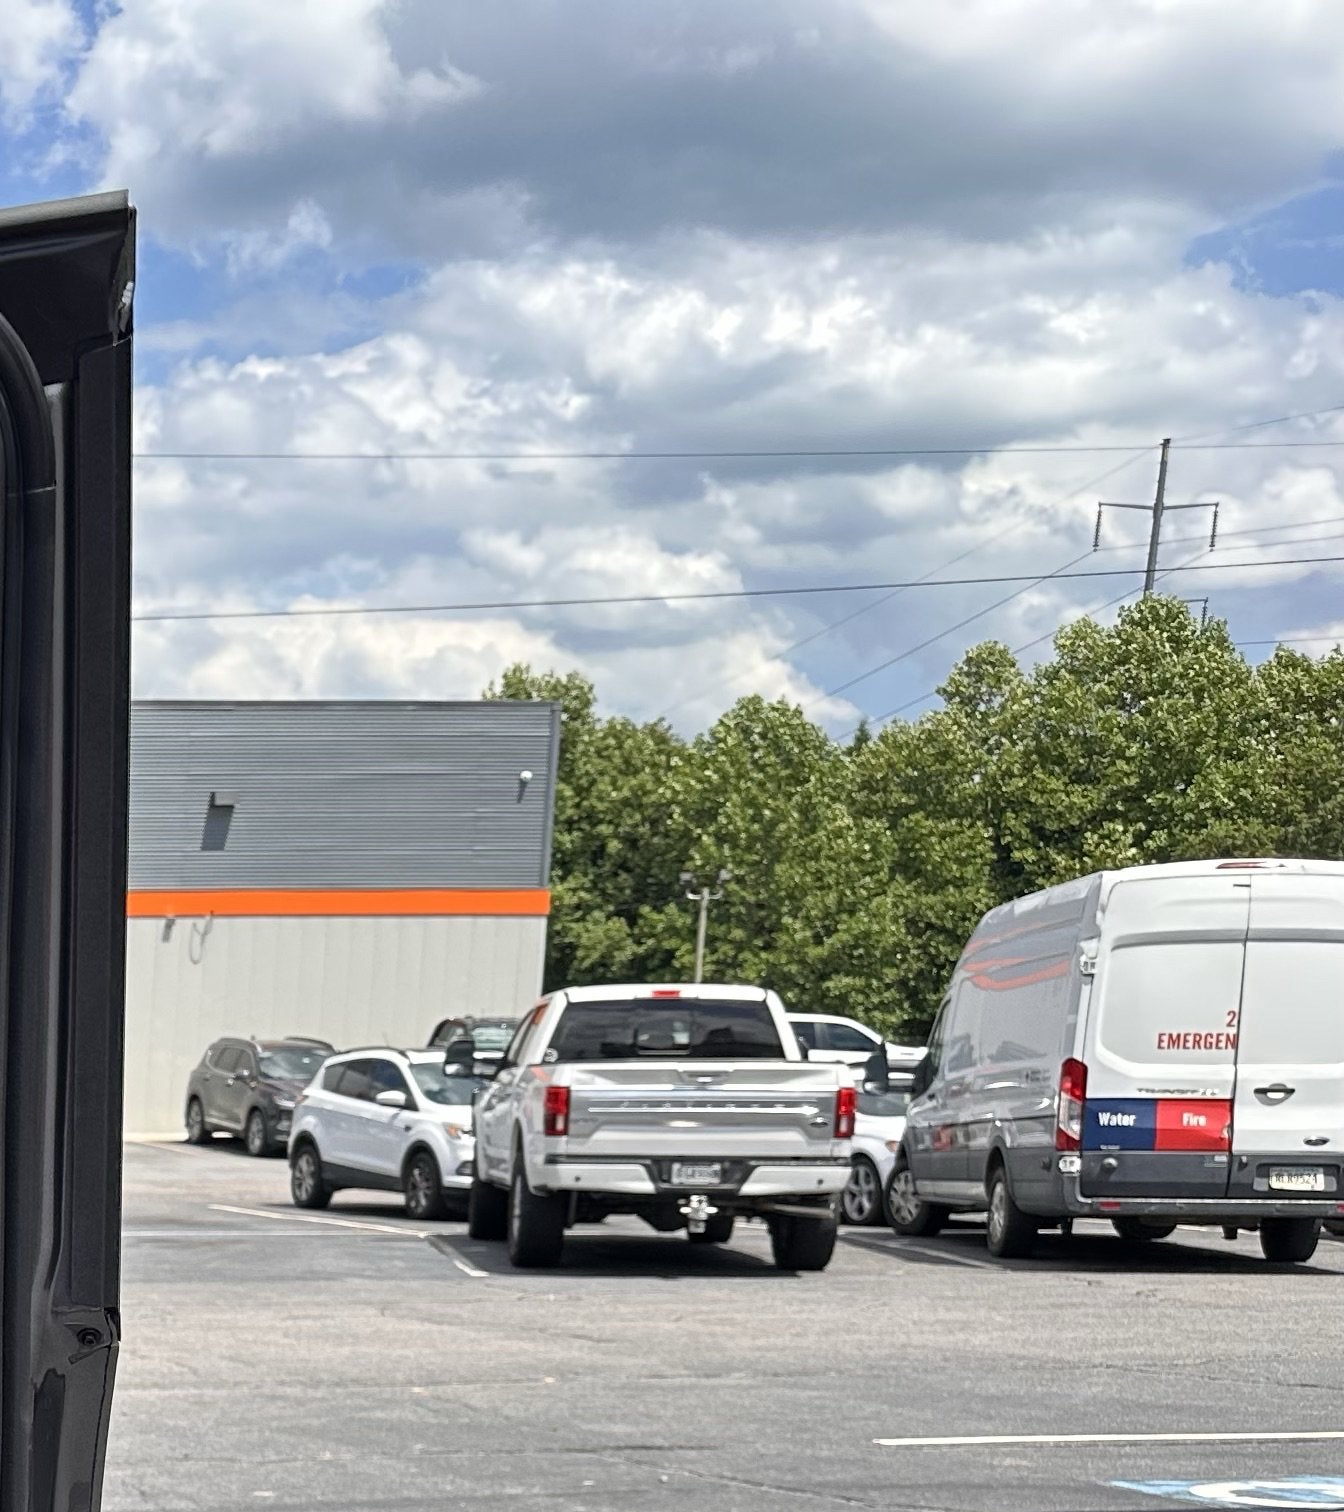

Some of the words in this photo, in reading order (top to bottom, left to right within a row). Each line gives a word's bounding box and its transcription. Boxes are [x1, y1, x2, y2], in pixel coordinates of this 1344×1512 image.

[1226, 1010, 1236, 1027] 2
[1157, 1033, 1237, 1050] EMERGEN
[1098, 1112, 1136, 1127] Water
[1182, 1112, 1208, 1127] Fire
